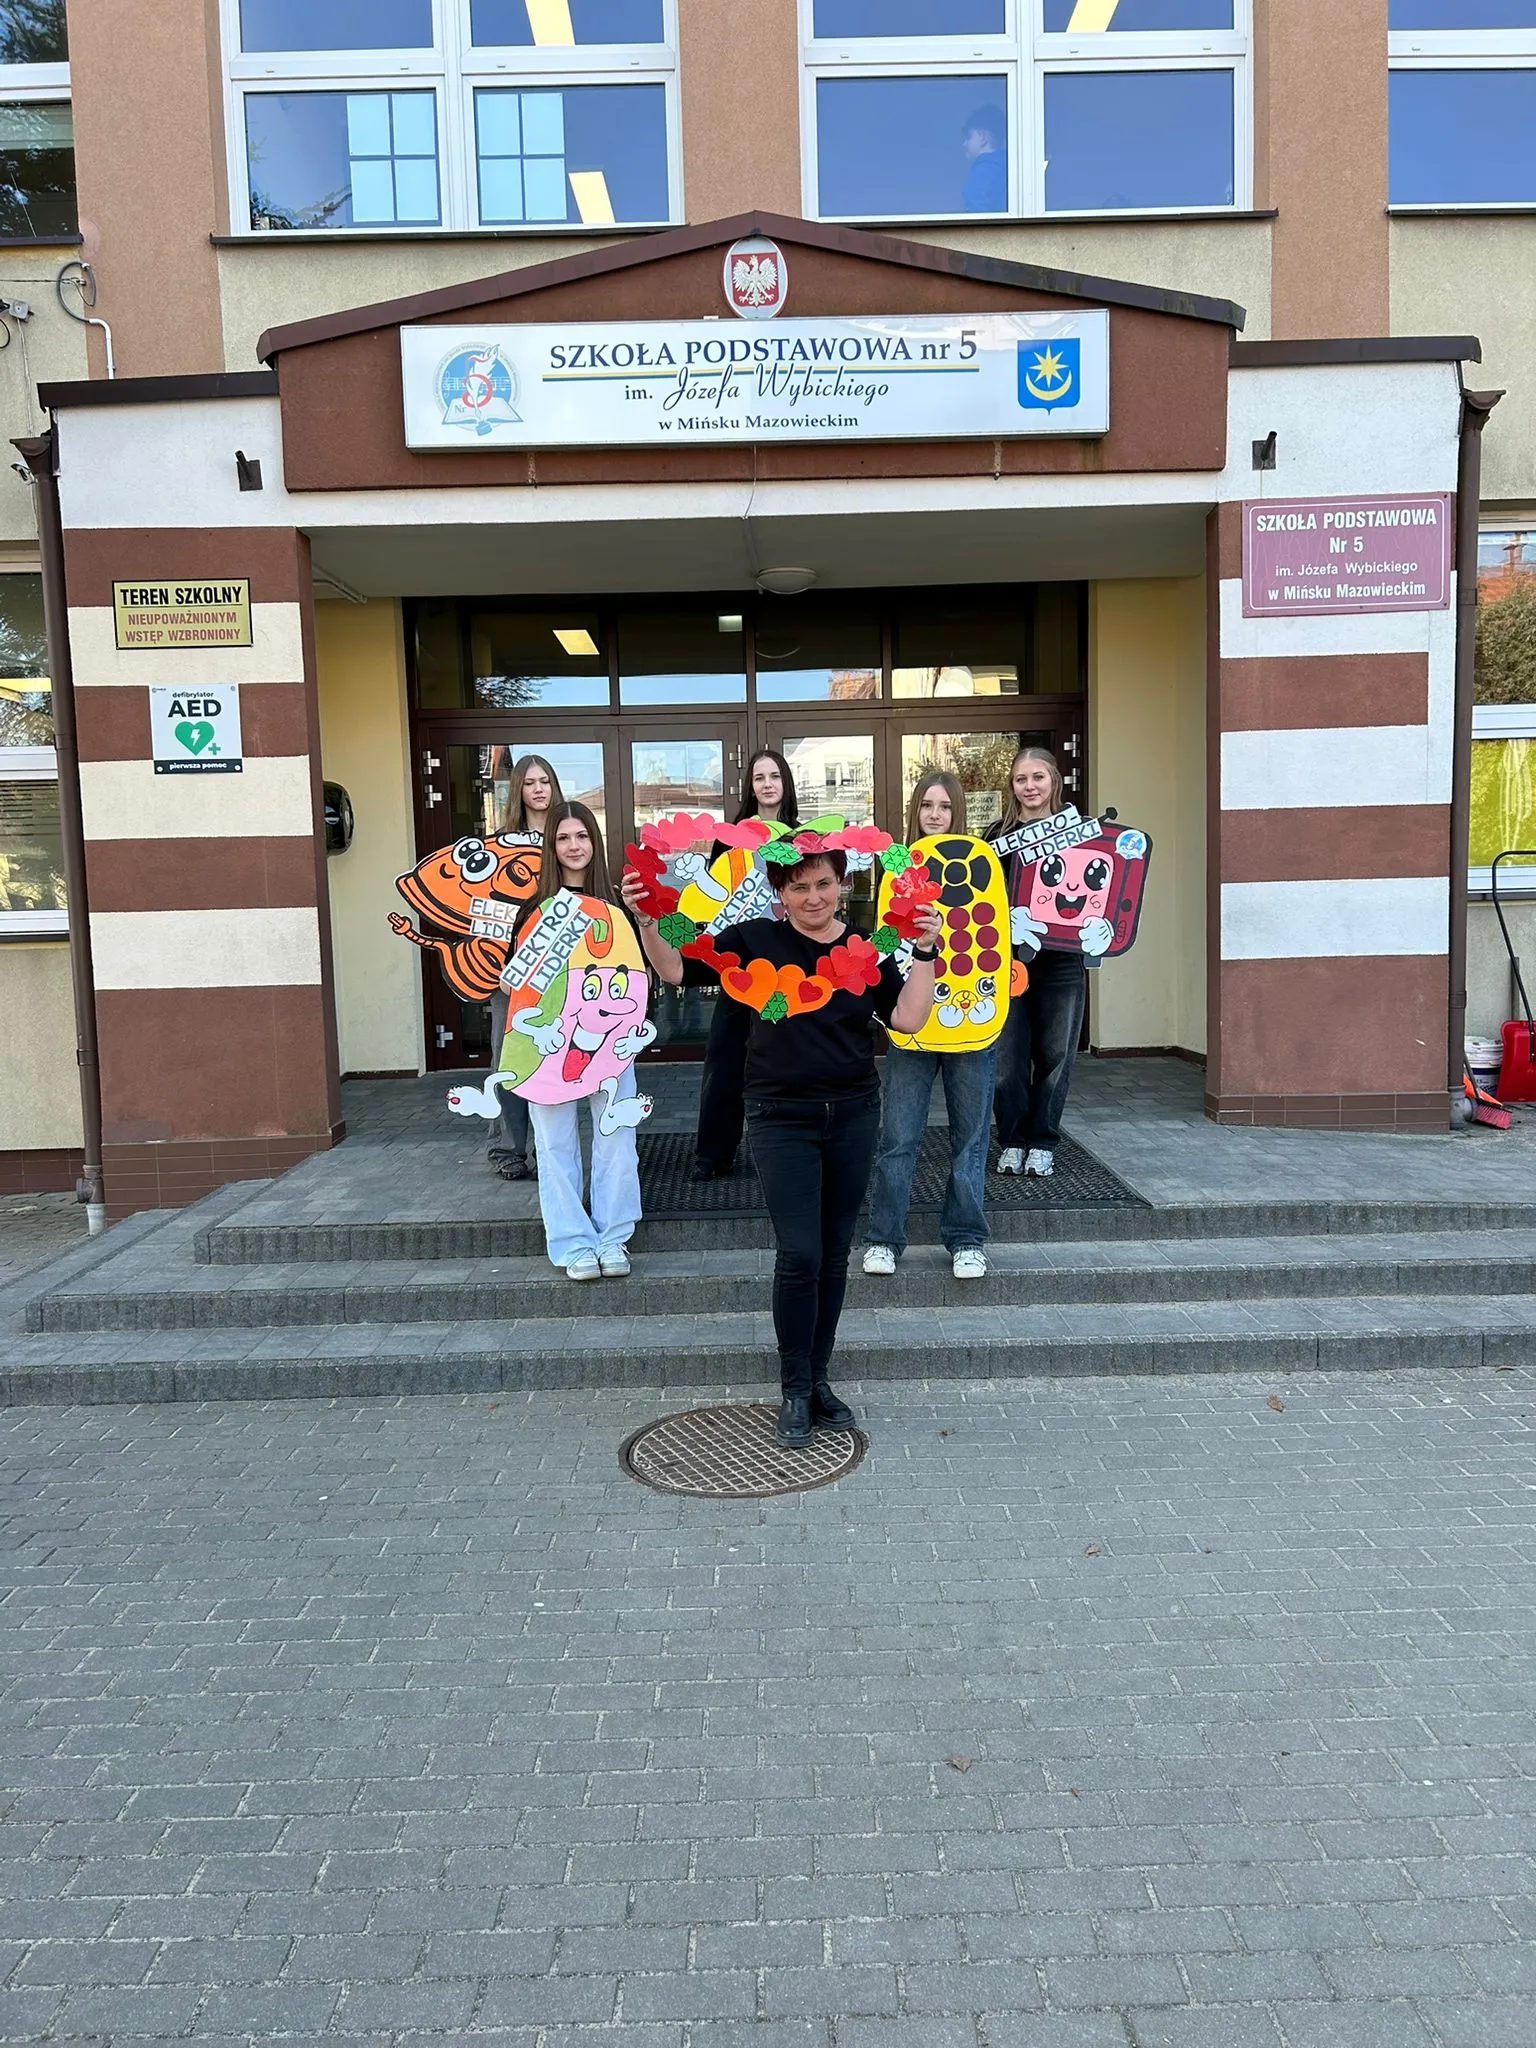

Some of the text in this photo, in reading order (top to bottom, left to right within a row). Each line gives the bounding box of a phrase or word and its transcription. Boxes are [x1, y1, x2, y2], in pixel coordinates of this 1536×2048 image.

[550, 330, 977, 368] SZKOŁA PODSTAWOWA nr 5
[624, 362, 889, 411] im. Józefa Wybickiego
[658, 414, 859, 431] w Mińsku Mazowieckim
[1256, 508, 1437, 532] SZKOŁA PODSTAWOWA
[1329, 536, 1364, 553] Nr 5
[1275, 560, 1418, 577] im. Józefa Wybickiego
[120, 586, 242, 605] TEREN SZKOLNY
[1268, 581, 1426, 601] w Mińsku Mazowieckim
[128, 610, 237, 626] NIEUPOWAŻNIONYM
[126, 628, 241, 644] WSTĘP WZBRONIONY
[172, 691, 214, 699] defibrylator
[168, 699, 222, 717] AED
[169, 762, 227, 771] pierwsza pomoc
[990, 814, 1078, 855] LEKTRO-
[1021, 821, 1100, 865] LIDERKI
[470, 898, 520, 921] ELEK
[502, 897, 573, 987] ELEKTRO-
[530, 911, 592, 993] LIDERKI
